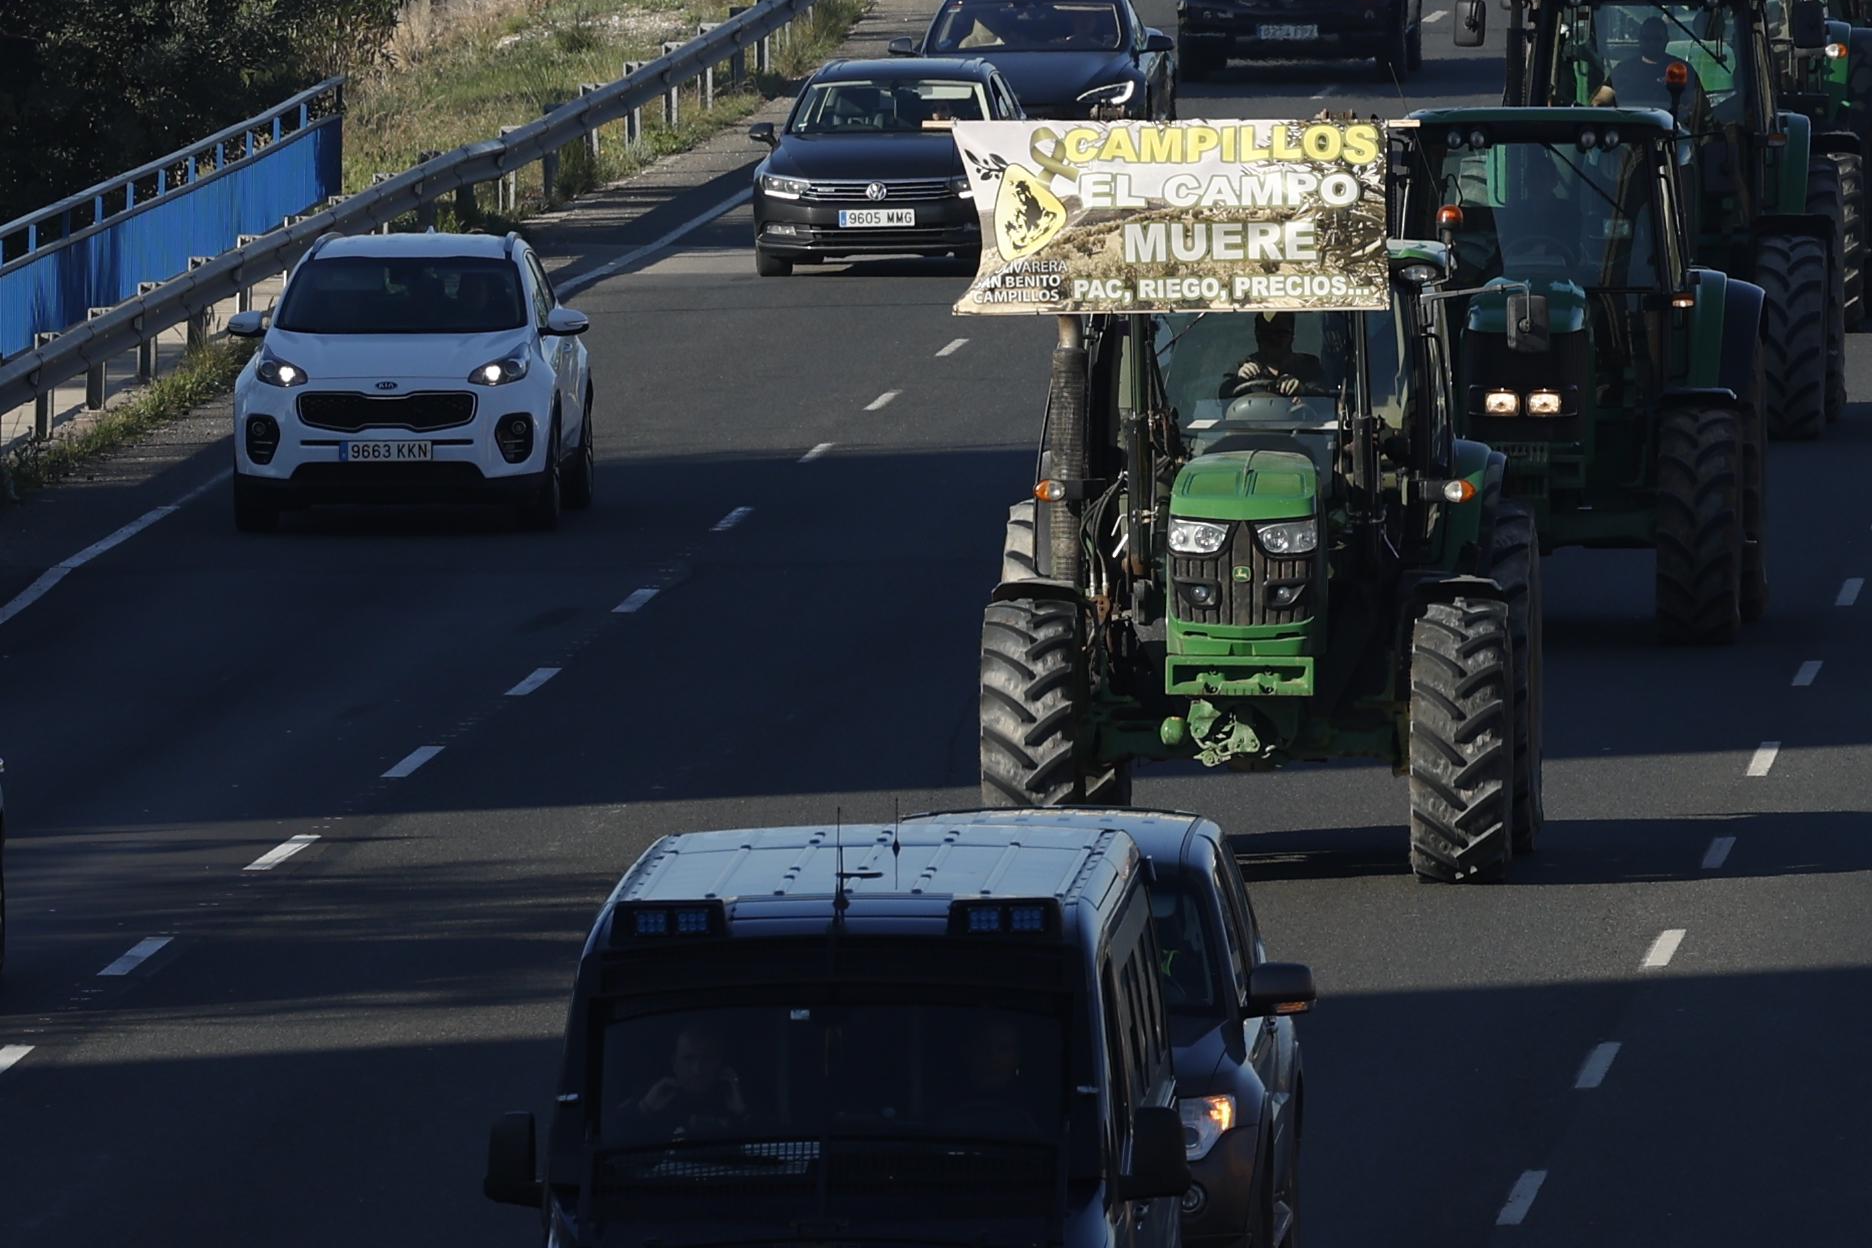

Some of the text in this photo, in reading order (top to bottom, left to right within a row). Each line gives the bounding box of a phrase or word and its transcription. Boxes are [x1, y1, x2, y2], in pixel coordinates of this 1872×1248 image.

[1063, 124, 1380, 165] CAMPILLOS
[1079, 171, 1360, 209] EL CAMPO
[849, 212, 913, 225] 9605 MMG
[1123, 221, 1319, 263] MUERE
[1005, 274, 1061, 288] BENITO
[1073, 275, 1370, 302] PAC, RIEGO, PRECIOS...
[973, 289, 1060, 304] CAMPILLOS
[351, 444, 428, 459] 9663 KKN
